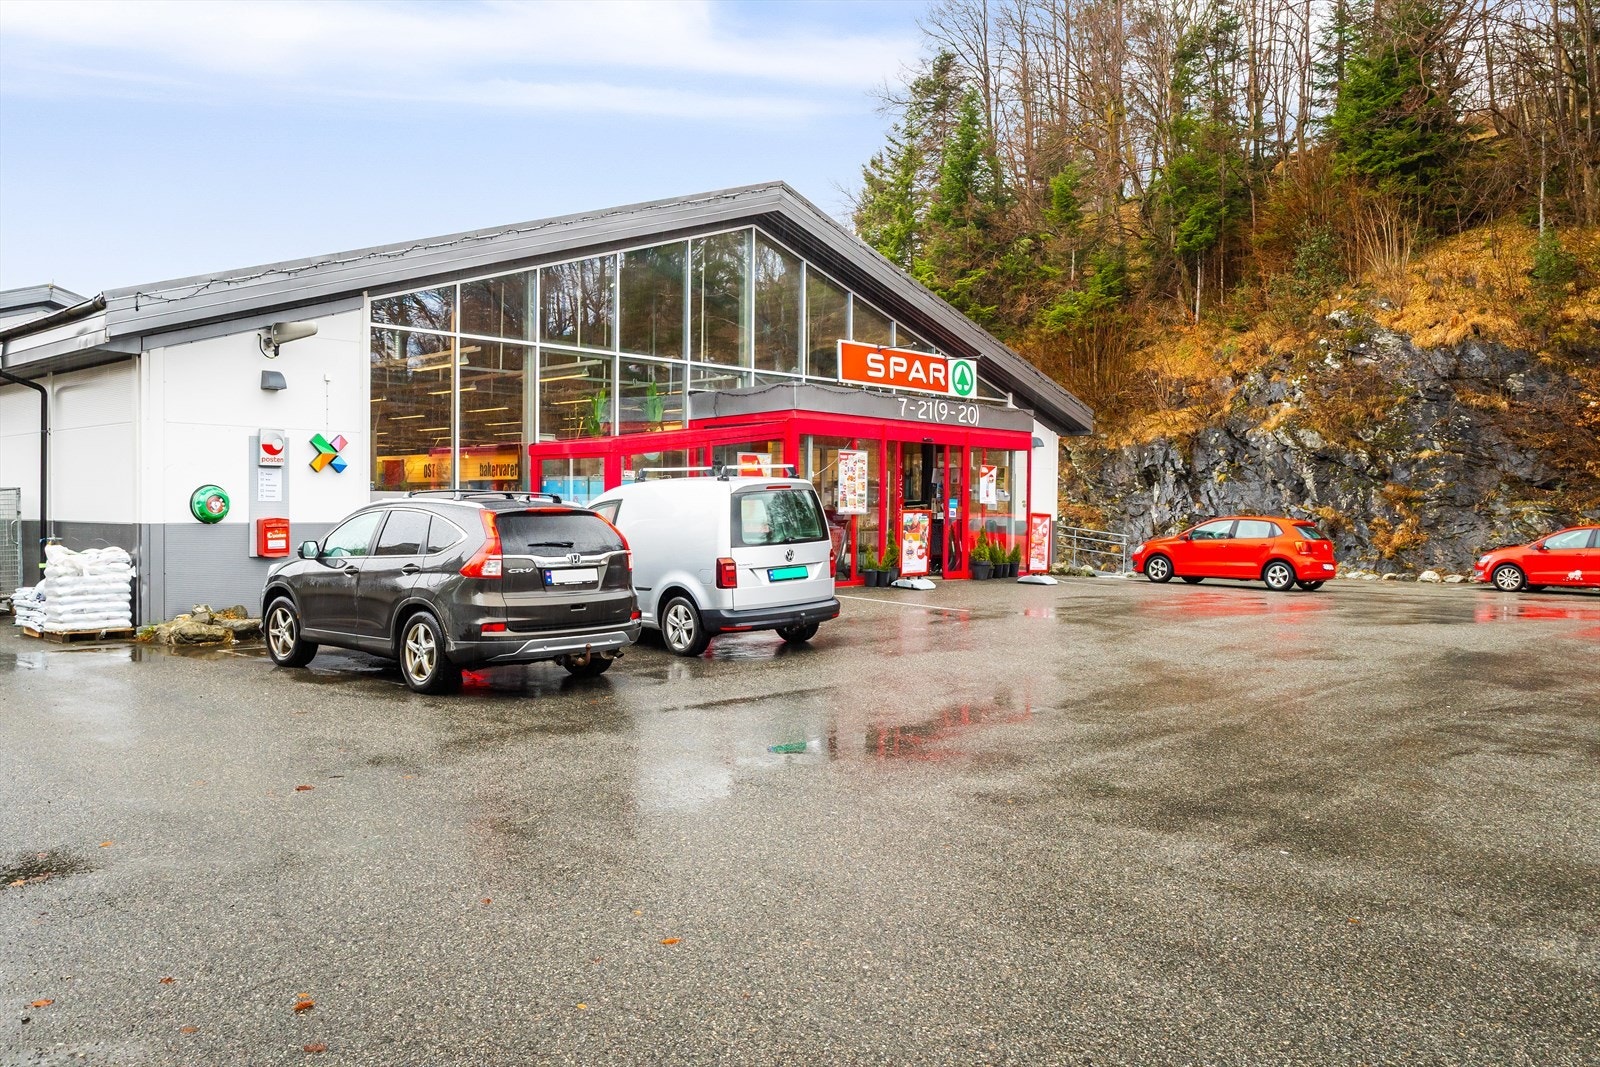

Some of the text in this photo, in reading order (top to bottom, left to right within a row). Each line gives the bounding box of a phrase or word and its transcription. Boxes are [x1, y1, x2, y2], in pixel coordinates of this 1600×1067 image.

[866, 352, 946, 387] SPAR
[423, 463, 436, 478] OST
[479, 462, 518, 478] bakervarer
